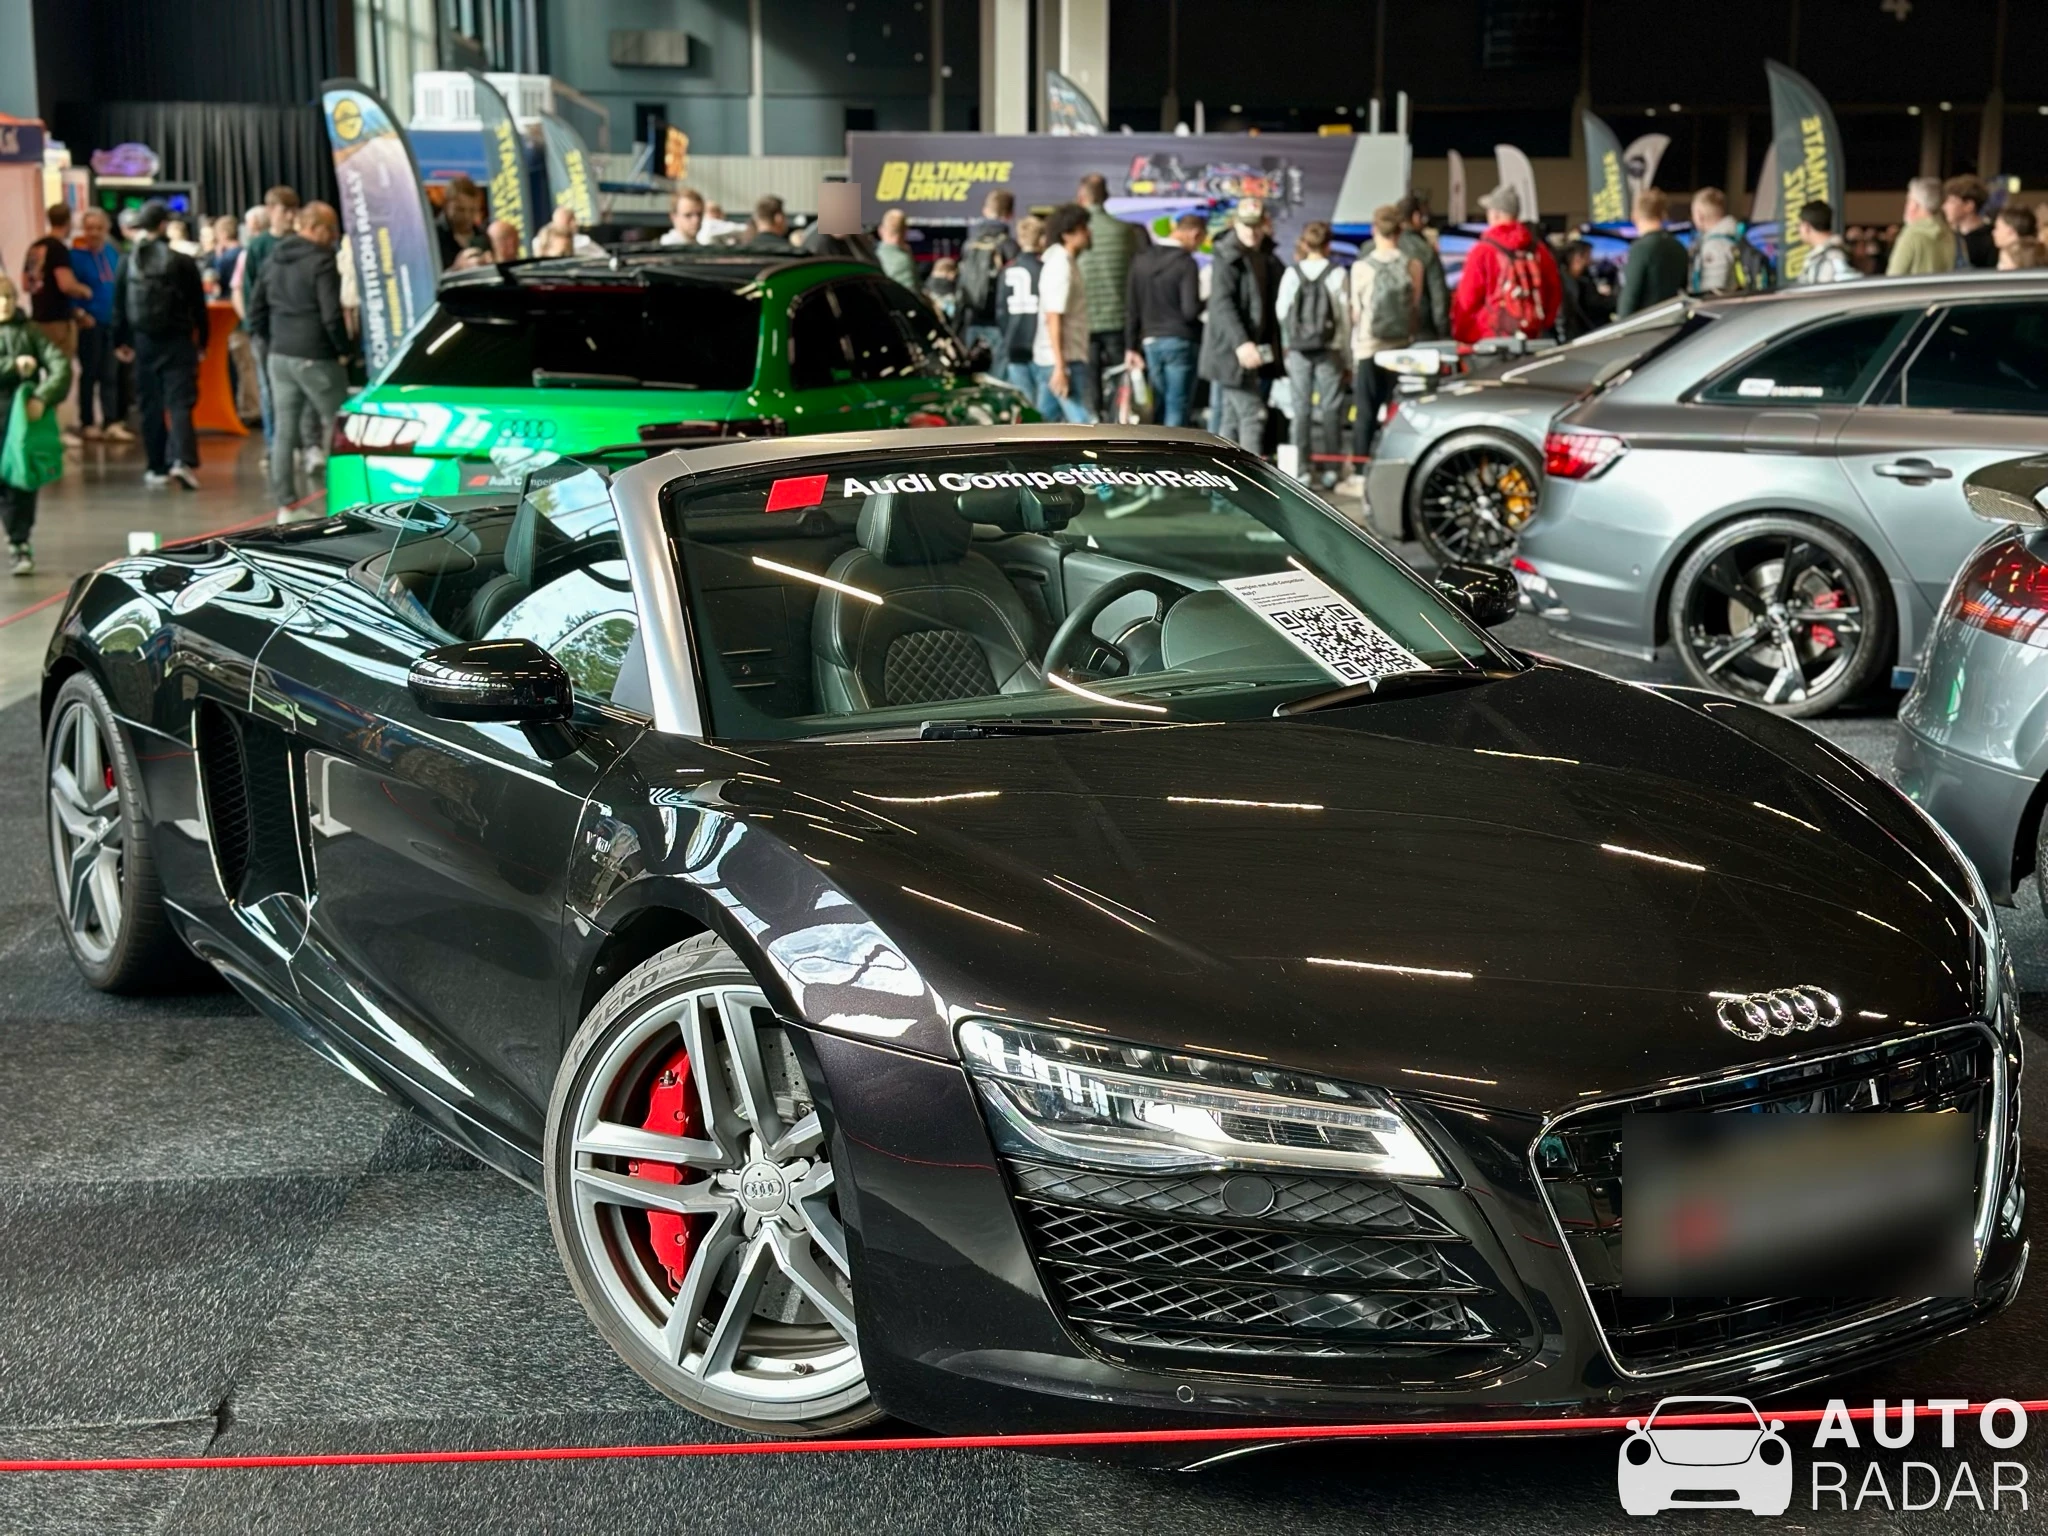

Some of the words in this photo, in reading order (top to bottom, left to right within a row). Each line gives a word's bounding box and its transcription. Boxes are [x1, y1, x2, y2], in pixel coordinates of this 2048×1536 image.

[905, 181, 971, 202] DRIVZ
[911, 161, 1014, 182] ULTIMATE
[346, 168, 371, 233] RALLY
[360, 233, 390, 369] COMPETITION
[1005, 267, 1039, 314] 1
[843, 473, 938, 498] Audi
[589, 970, 660, 1041] ZERO
